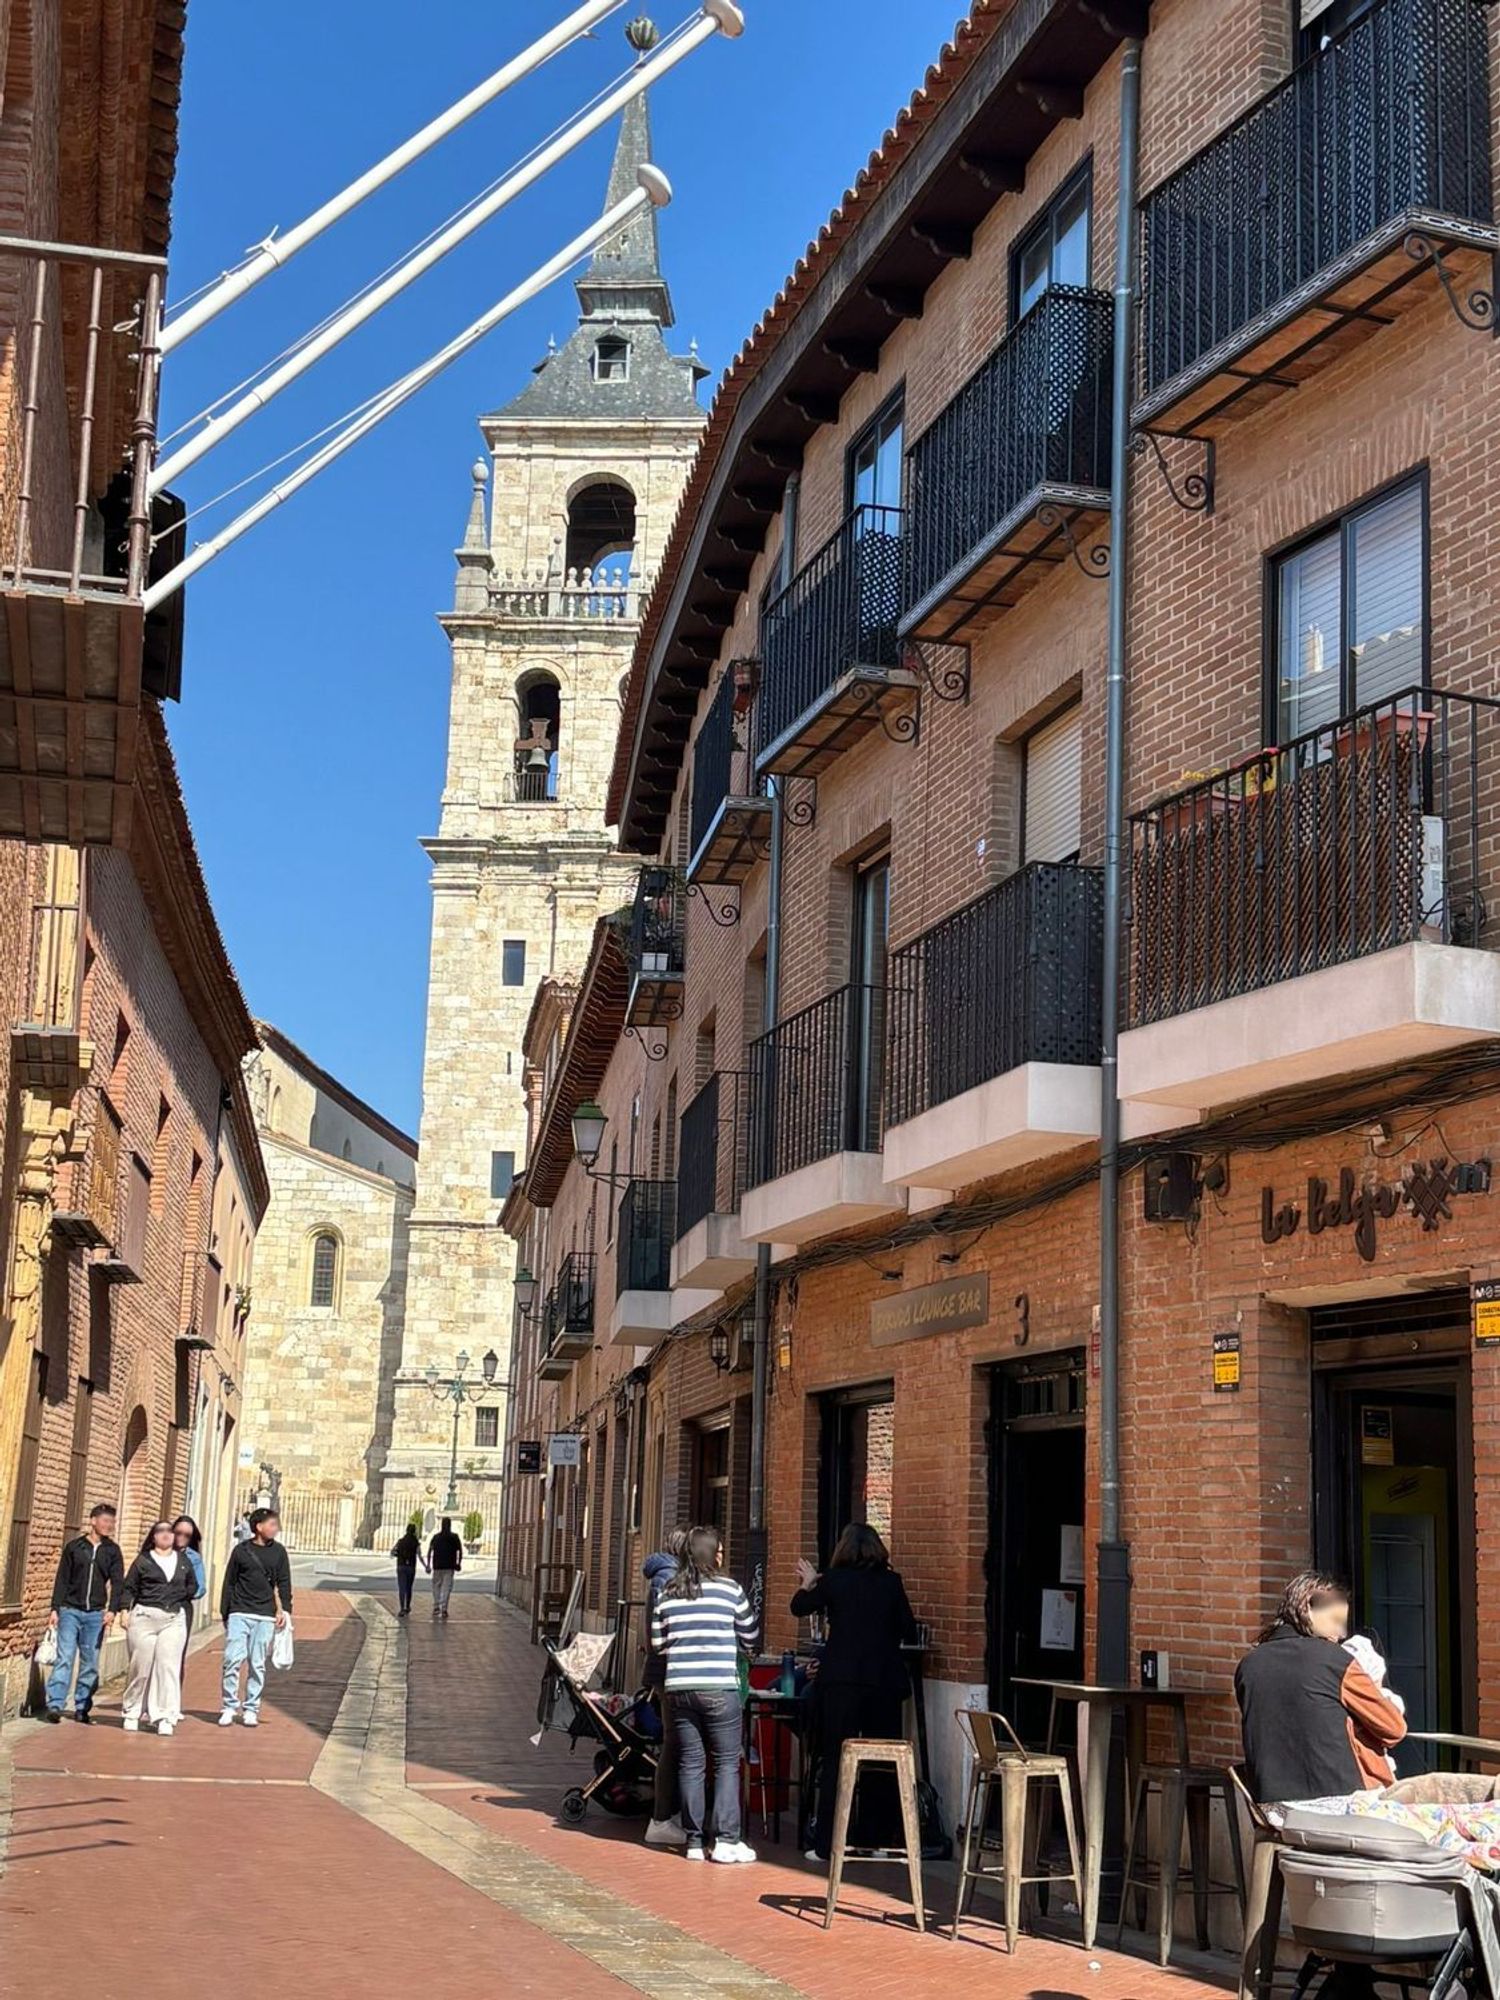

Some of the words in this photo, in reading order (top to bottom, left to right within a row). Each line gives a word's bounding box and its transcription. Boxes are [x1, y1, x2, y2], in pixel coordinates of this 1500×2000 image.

[913, 1296, 956, 1324] LOUNGE
[958, 1289, 981, 1315] BAR
[1014, 1293, 1030, 1346] 3
